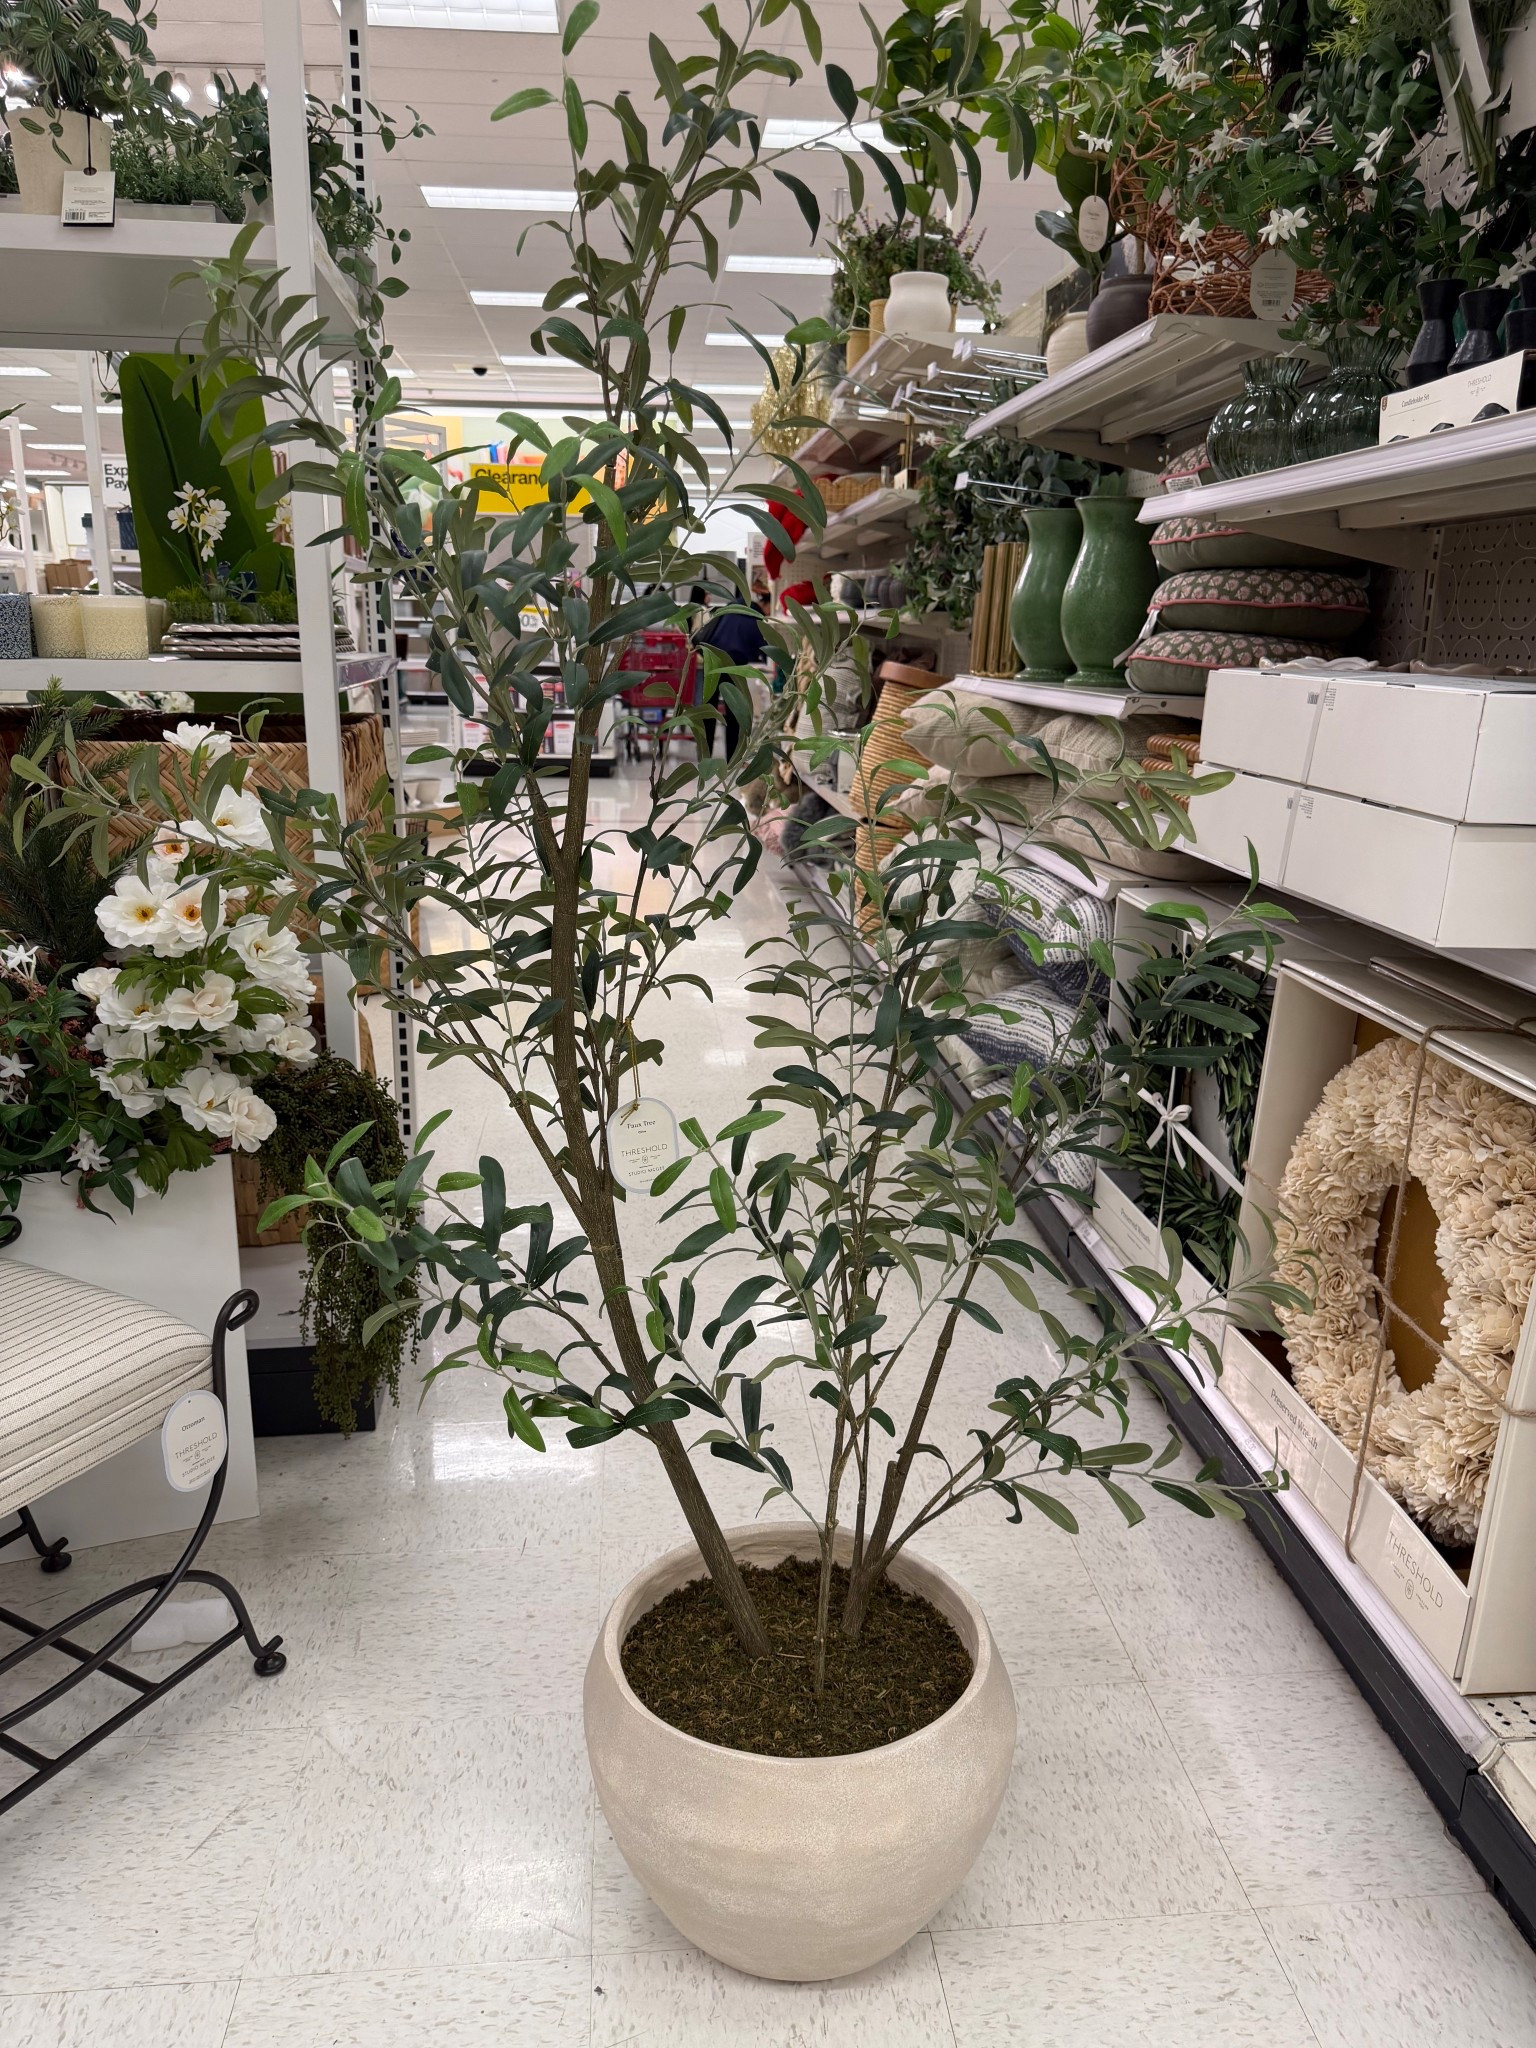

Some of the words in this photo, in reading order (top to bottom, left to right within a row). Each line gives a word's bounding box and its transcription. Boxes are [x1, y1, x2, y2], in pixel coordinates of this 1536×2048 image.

[105, 476, 128, 491] Pay
[475, 468, 541, 485] Clearan
[621, 1143, 668, 1158] THRESHOLD
[1270, 1388, 1298, 1425] Preserved
[181, 1416, 206, 1432] Ottoman
[175, 1432, 218, 1459] THRESHOLD
[1388, 1531, 1443, 1608] THRESHOLD
